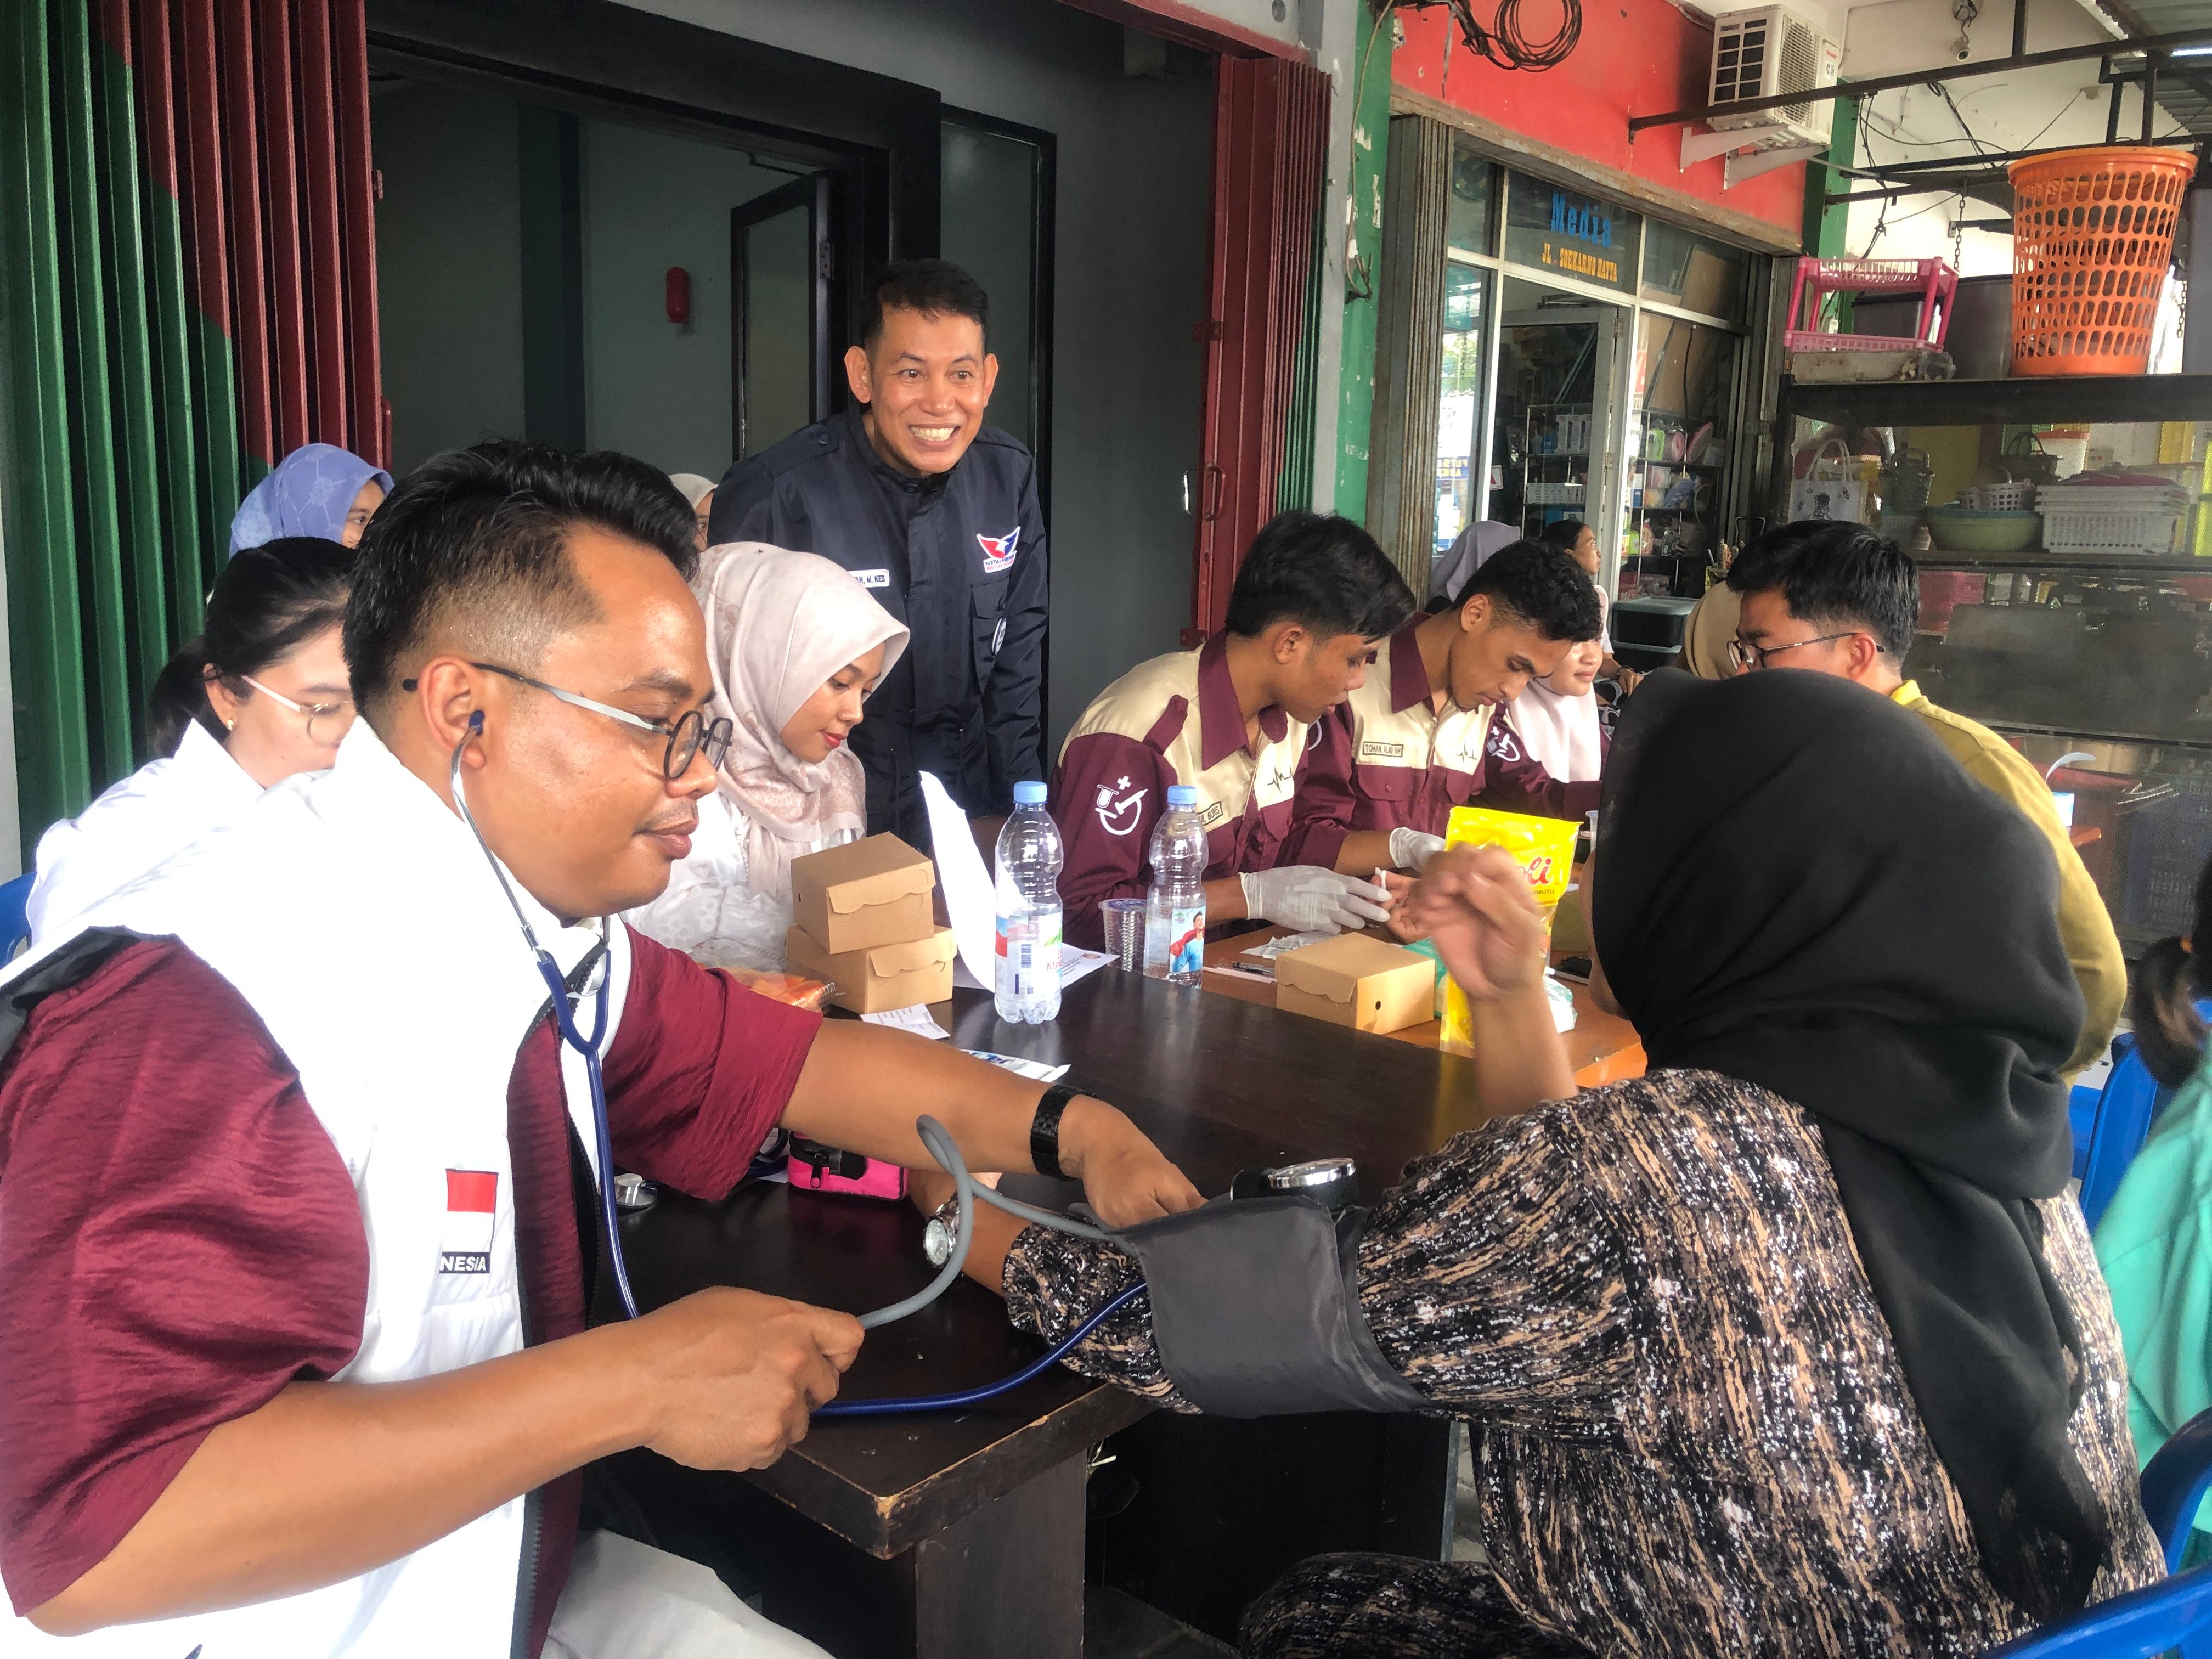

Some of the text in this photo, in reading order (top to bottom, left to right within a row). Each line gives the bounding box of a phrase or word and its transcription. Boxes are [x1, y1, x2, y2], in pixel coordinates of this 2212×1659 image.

[1551, 192, 1611, 249] Media
[1560, 247, 1596, 276] SOEKARNO
[1597, 258, 1617, 283] HATTA
[439, 1256, 486, 1271] NESIA
